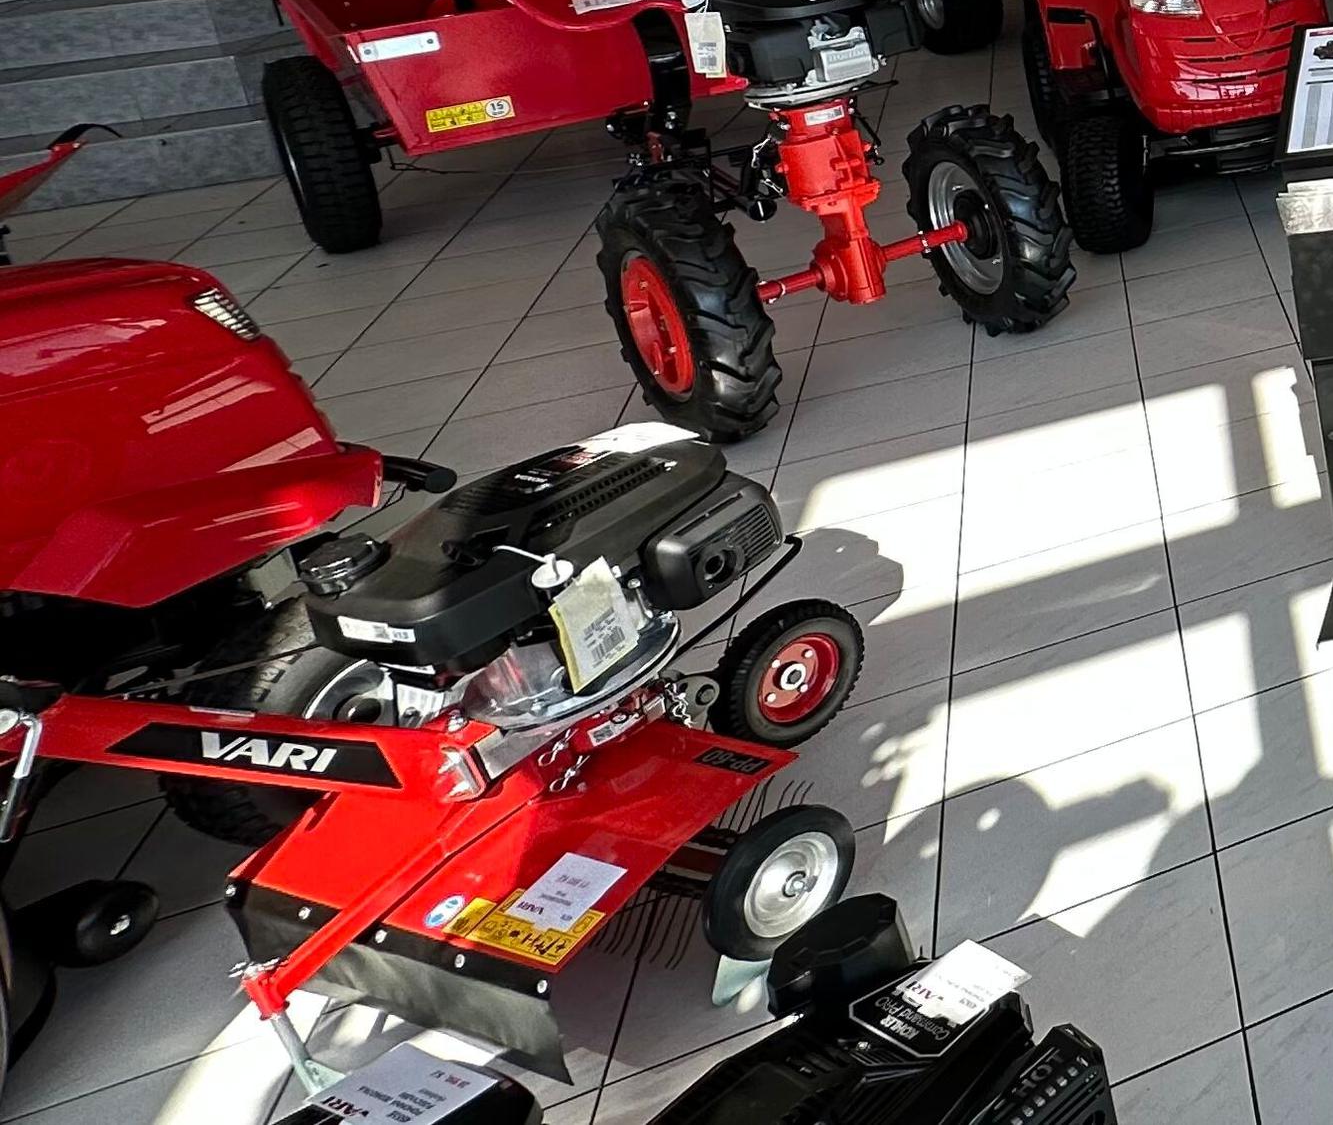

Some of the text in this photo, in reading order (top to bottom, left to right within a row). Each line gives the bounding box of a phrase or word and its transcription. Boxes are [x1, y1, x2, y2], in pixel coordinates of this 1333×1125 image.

[490, 101, 504, 111] 15
[200, 731, 337, 772] VARI
[874, 996, 950, 1041] Command PRO
[880, 1014, 920, 1040] KOHLER
